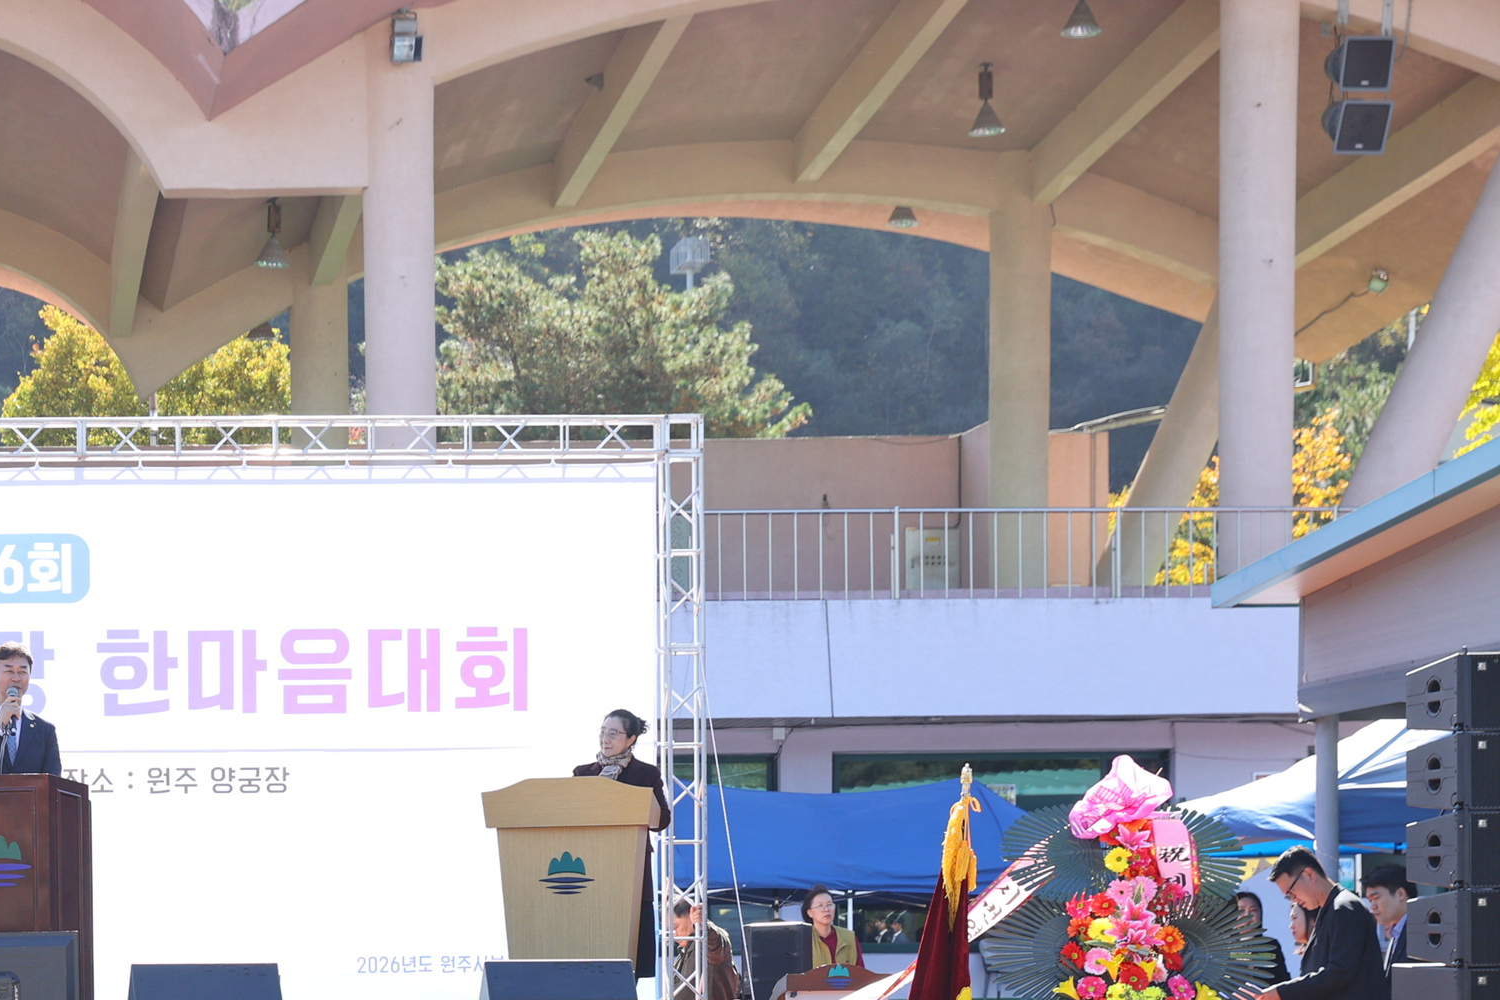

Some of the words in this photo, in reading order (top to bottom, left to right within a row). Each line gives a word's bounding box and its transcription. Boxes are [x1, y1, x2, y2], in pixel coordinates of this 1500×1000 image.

[96, 626, 528, 716] 한마음대회
[147, 767, 198, 794] 원주
[211, 766, 290, 794] 양궁장
[1158, 845, 1190, 864] 祝
[357, 955, 433, 974] 2026년도
